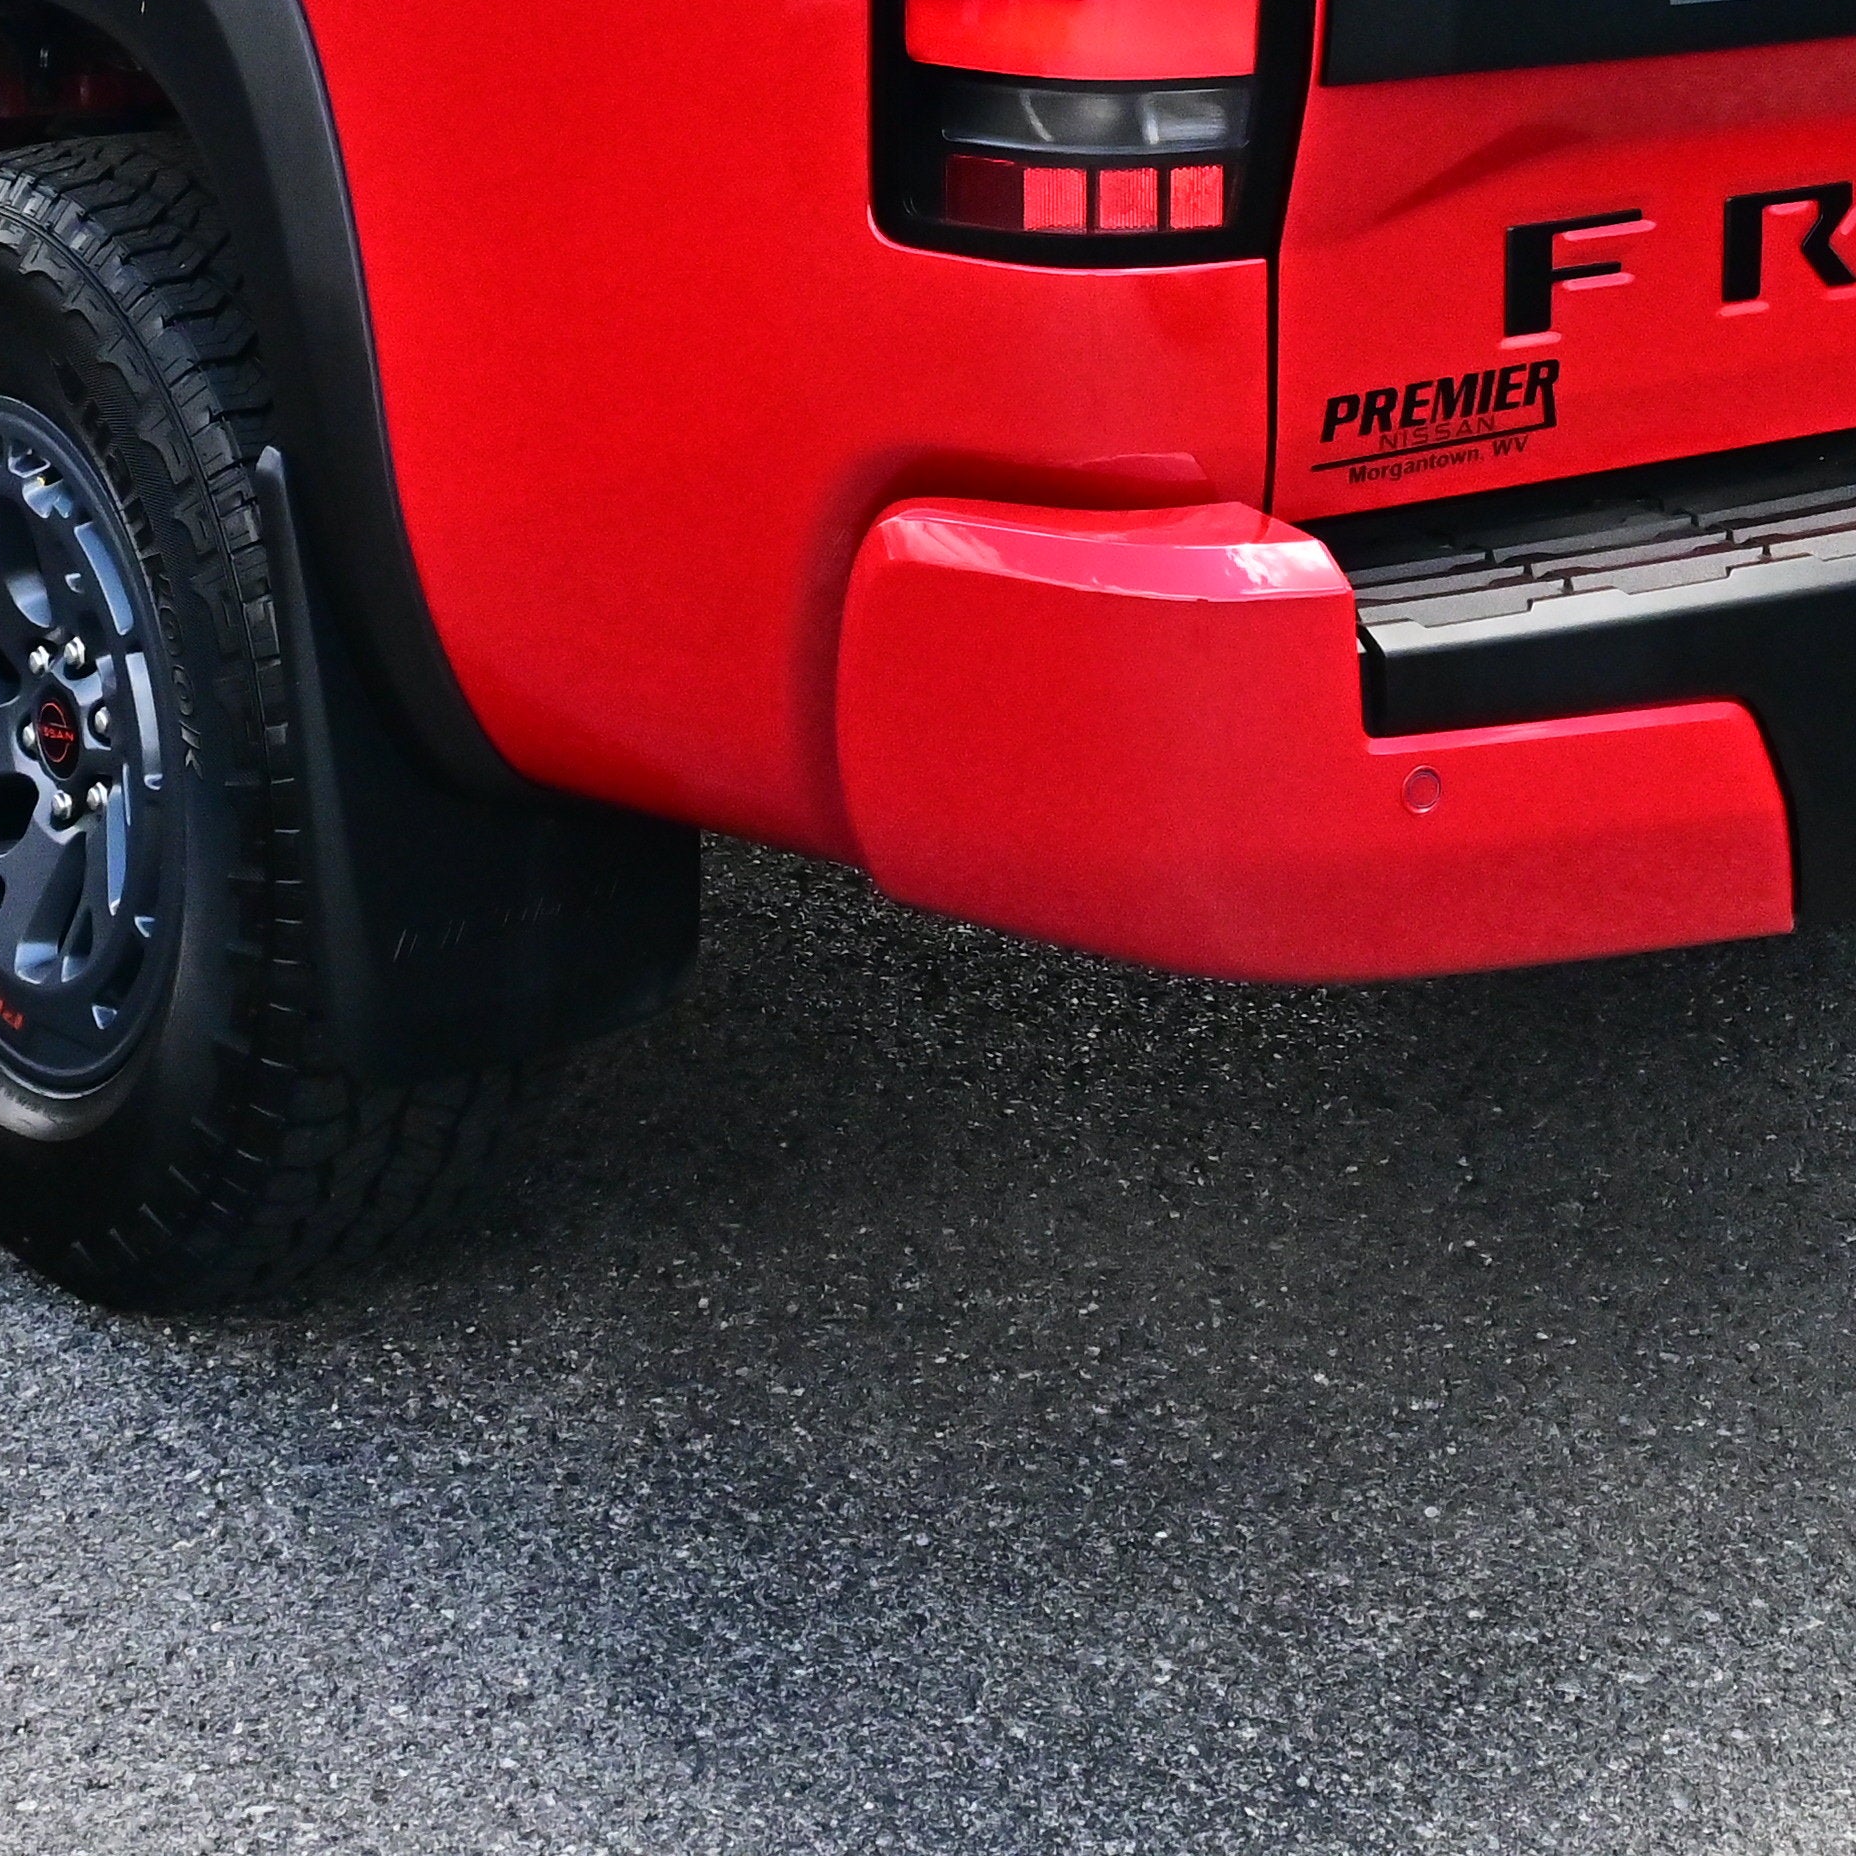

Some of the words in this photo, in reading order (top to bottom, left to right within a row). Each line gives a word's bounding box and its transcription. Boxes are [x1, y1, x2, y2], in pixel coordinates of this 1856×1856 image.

[1319, 358, 1560, 443] PREMIER
[1377, 414, 1496, 452] NISSAN
[1491, 434, 1529, 457] WV
